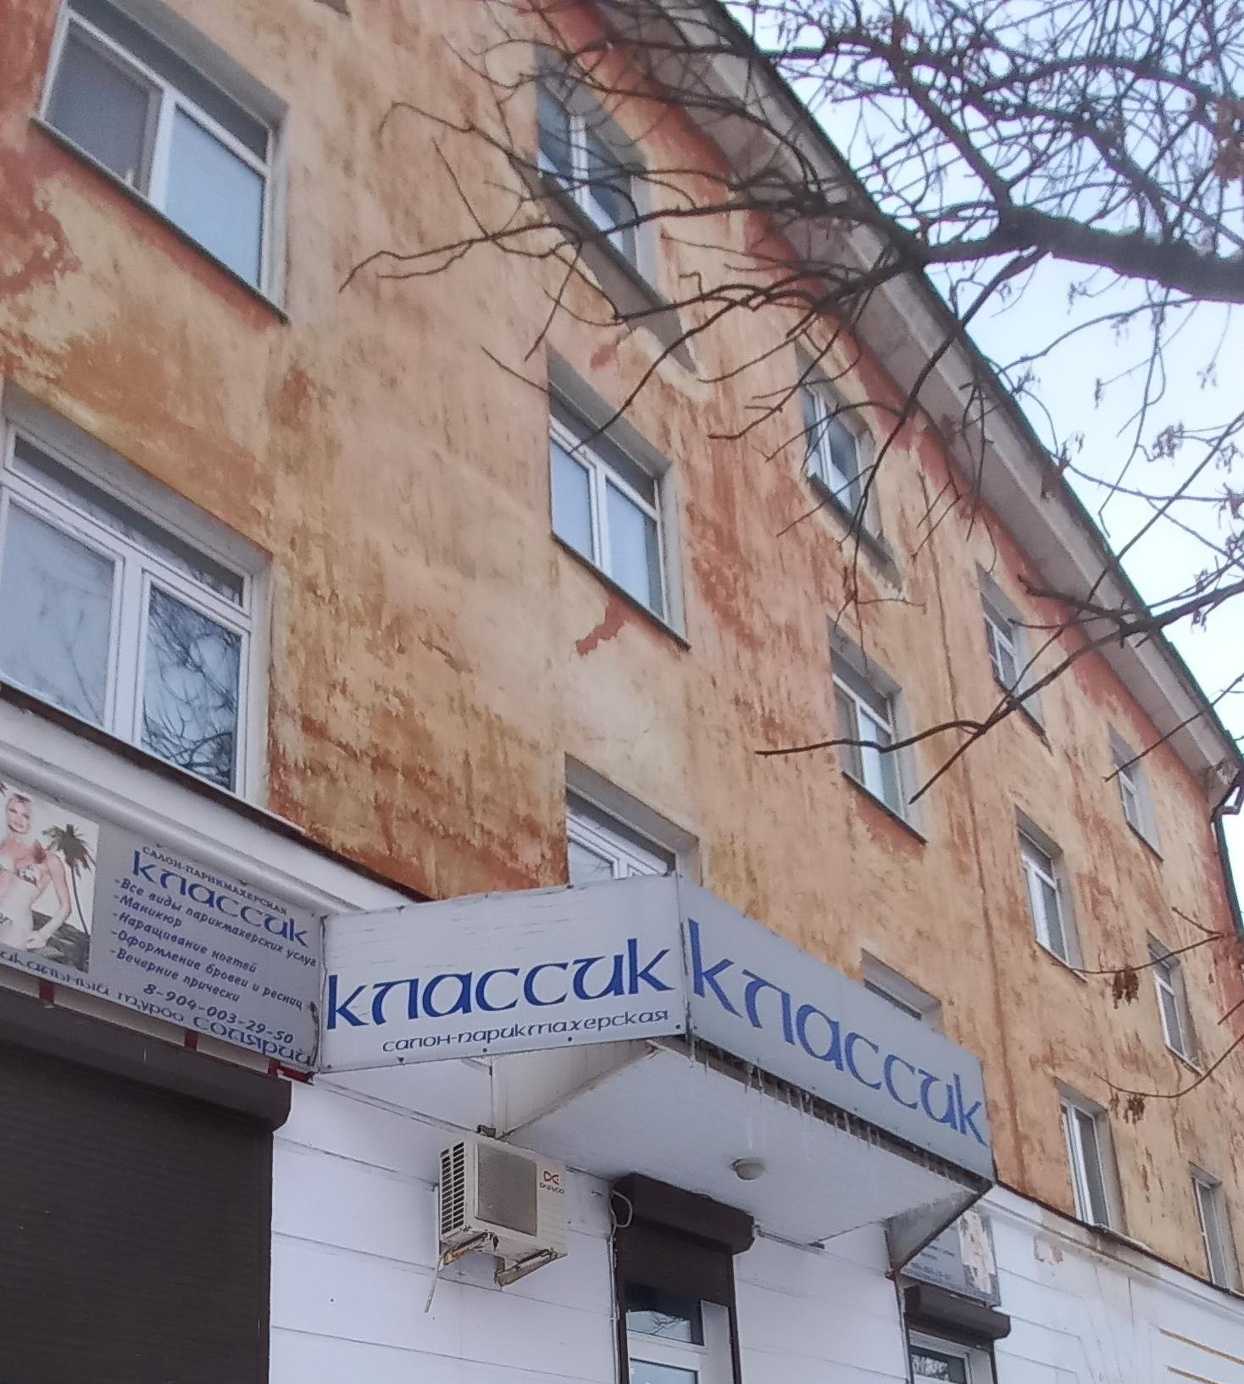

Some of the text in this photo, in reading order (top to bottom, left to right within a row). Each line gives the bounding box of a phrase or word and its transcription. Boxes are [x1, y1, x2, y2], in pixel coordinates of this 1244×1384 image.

[185, 907, 283, 954] парикмахерских
[286, 949, 317, 967] услуг
[183, 975, 241, 1003] прически
[252, 984, 260, 992] и
